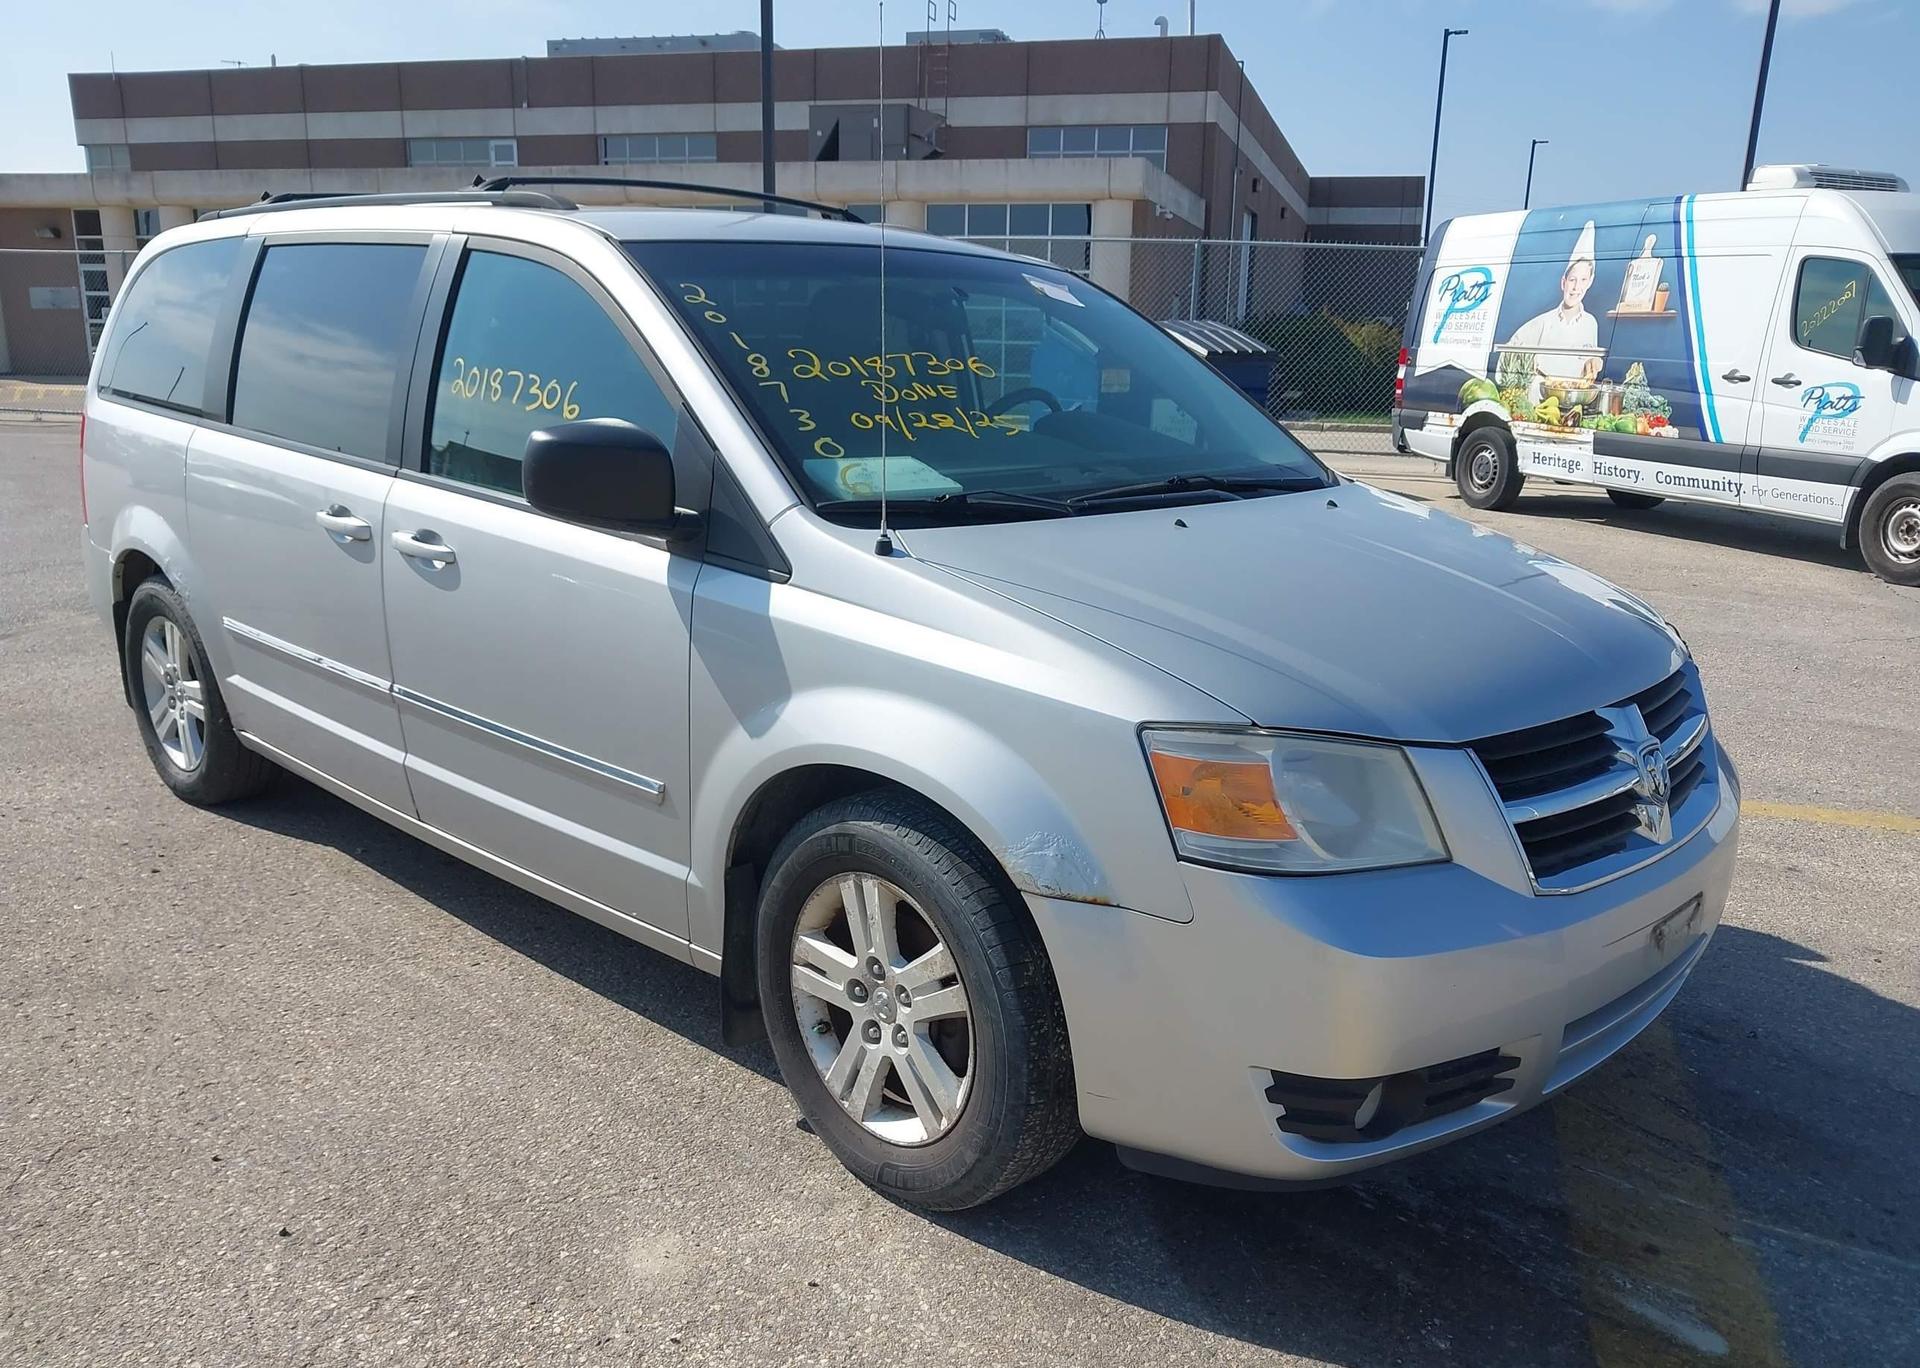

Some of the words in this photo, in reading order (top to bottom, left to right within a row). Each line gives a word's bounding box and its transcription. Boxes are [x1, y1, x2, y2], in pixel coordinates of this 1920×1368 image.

[1438, 274, 1496, 302] Pratts
[1434, 322, 1453, 331] FD
[1454, 322, 1485, 331] SERVICE
[1436, 312, 1488, 320] WOLESALE
[787, 349, 995, 381] 20187306
[452, 357, 580, 420] 20187306
[1803, 386, 1865, 412] Pratts
[1800, 416, 1858, 428] WOLESALE
[1823, 426, 1857, 436] SERVICE
[1532, 452, 1584, 473] Heritage.
[1593, 462, 1645, 483] History.
[1655, 471, 1747, 497] Community.
[1751, 485, 1768, 497] For
[1771, 487, 1844, 508] Generations...
